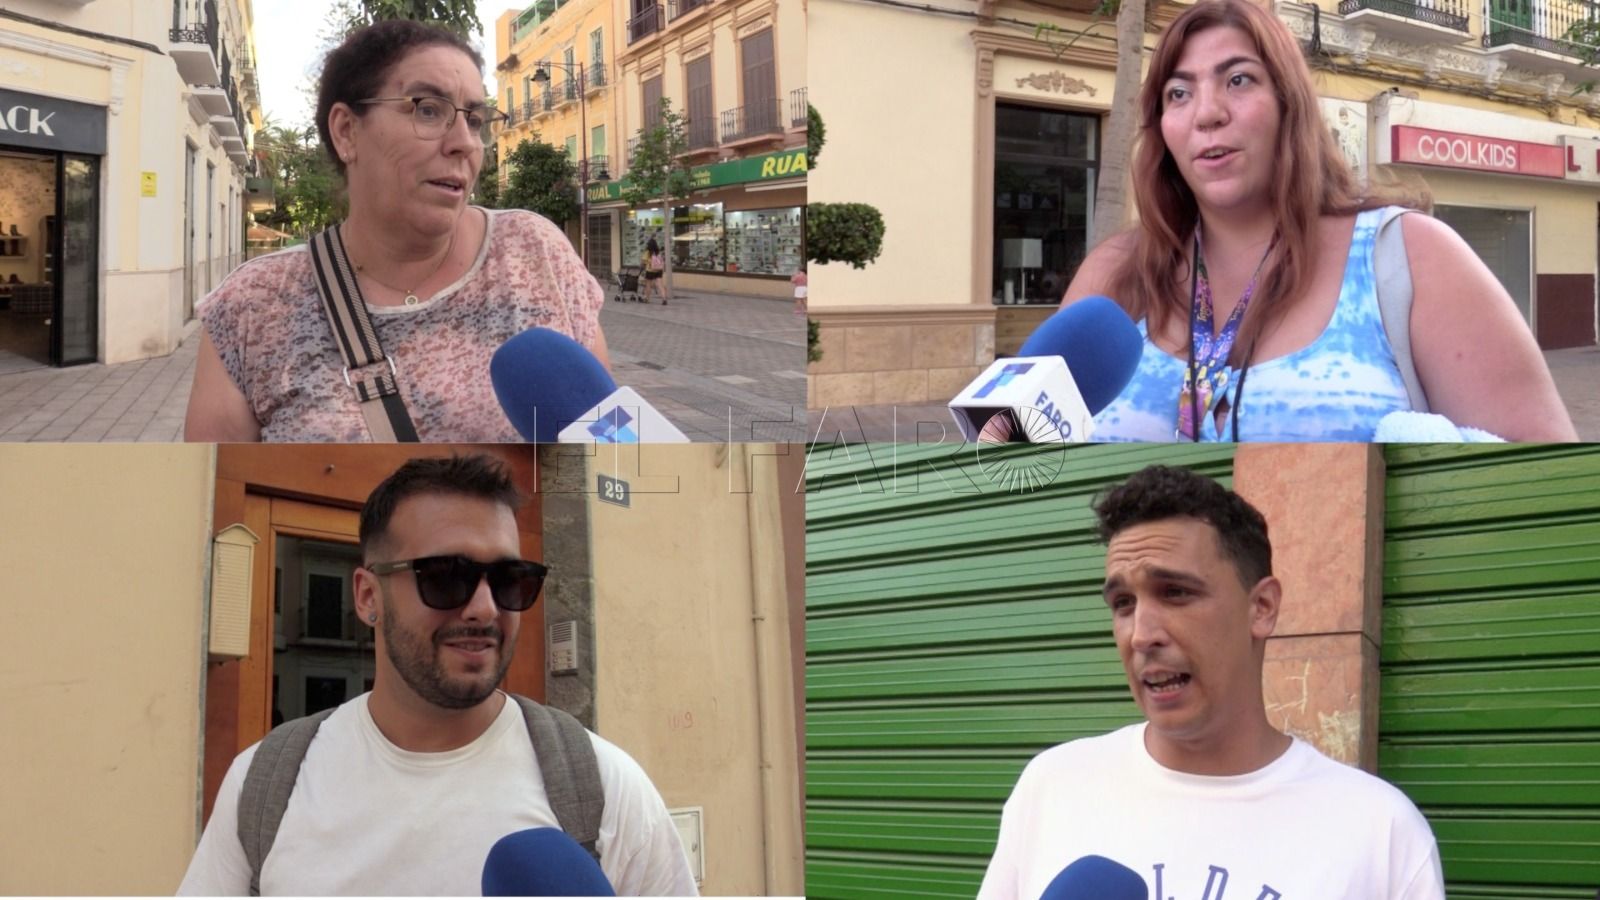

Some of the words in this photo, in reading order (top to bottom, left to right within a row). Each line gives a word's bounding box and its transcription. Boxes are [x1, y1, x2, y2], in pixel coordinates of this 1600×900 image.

[1418, 134, 1517, 169] COOLKIDS
[761, 152, 808, 177] RUA
[586, 185, 612, 201] RUAL
[1034, 390, 1072, 439] FARO
[604, 480, 625, 501] 29
